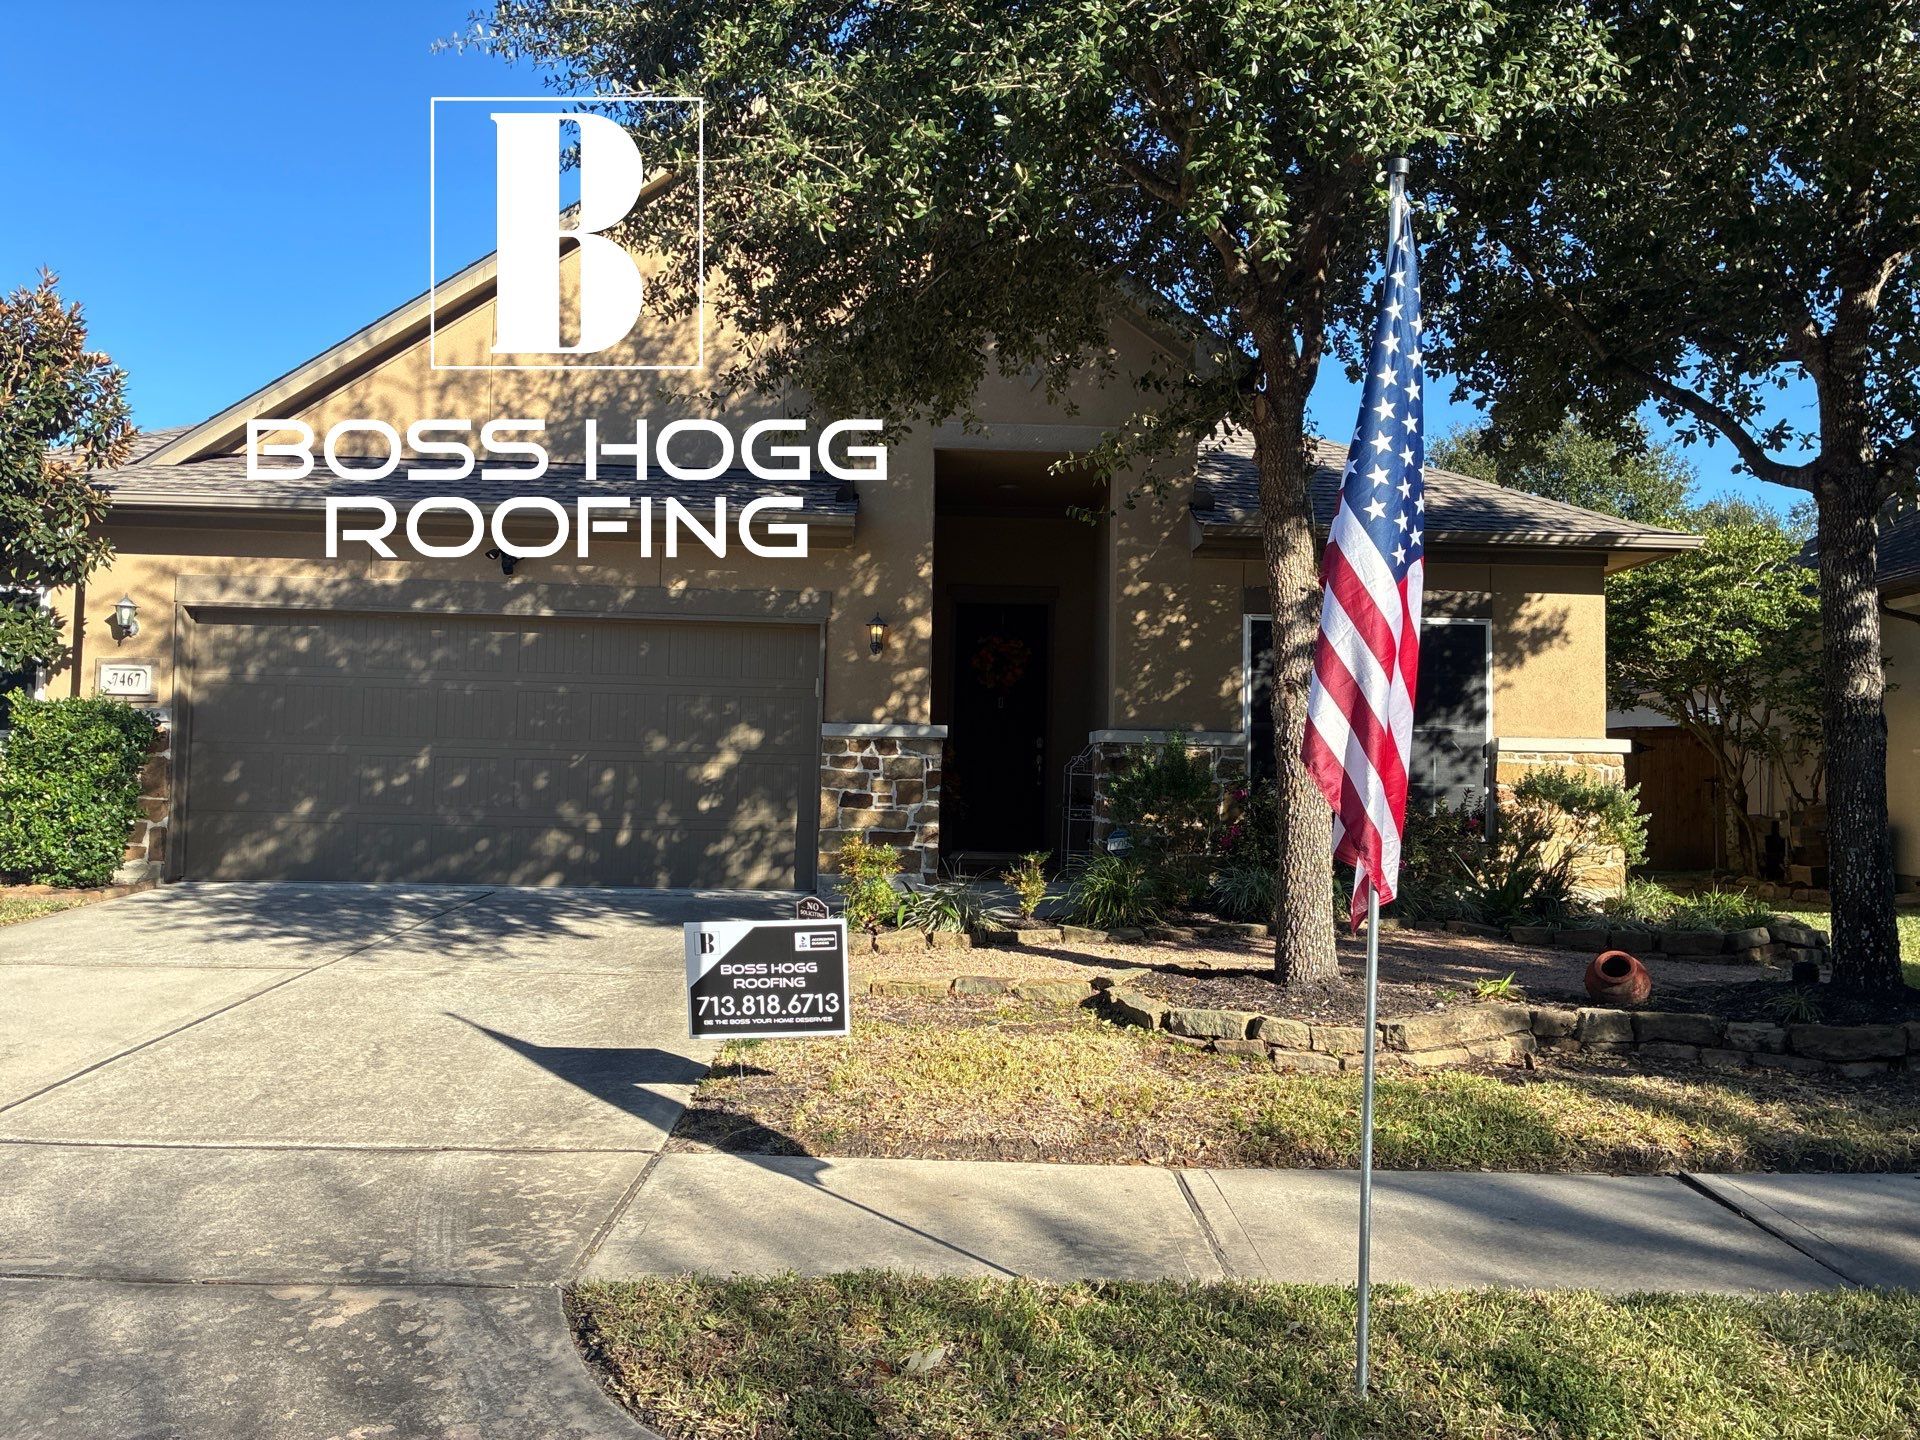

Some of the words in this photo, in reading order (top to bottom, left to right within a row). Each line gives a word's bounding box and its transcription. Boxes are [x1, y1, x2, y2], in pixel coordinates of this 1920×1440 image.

[112, 673, 141, 686] 7467
[807, 902, 819, 911] NO
[701, 933, 714, 954] B
[720, 964, 767, 975] BOSS
[771, 962, 818, 973] HOGG
[733, 977, 806, 989] ROOFING
[697, 993, 839, 1016] 713.818.6713
